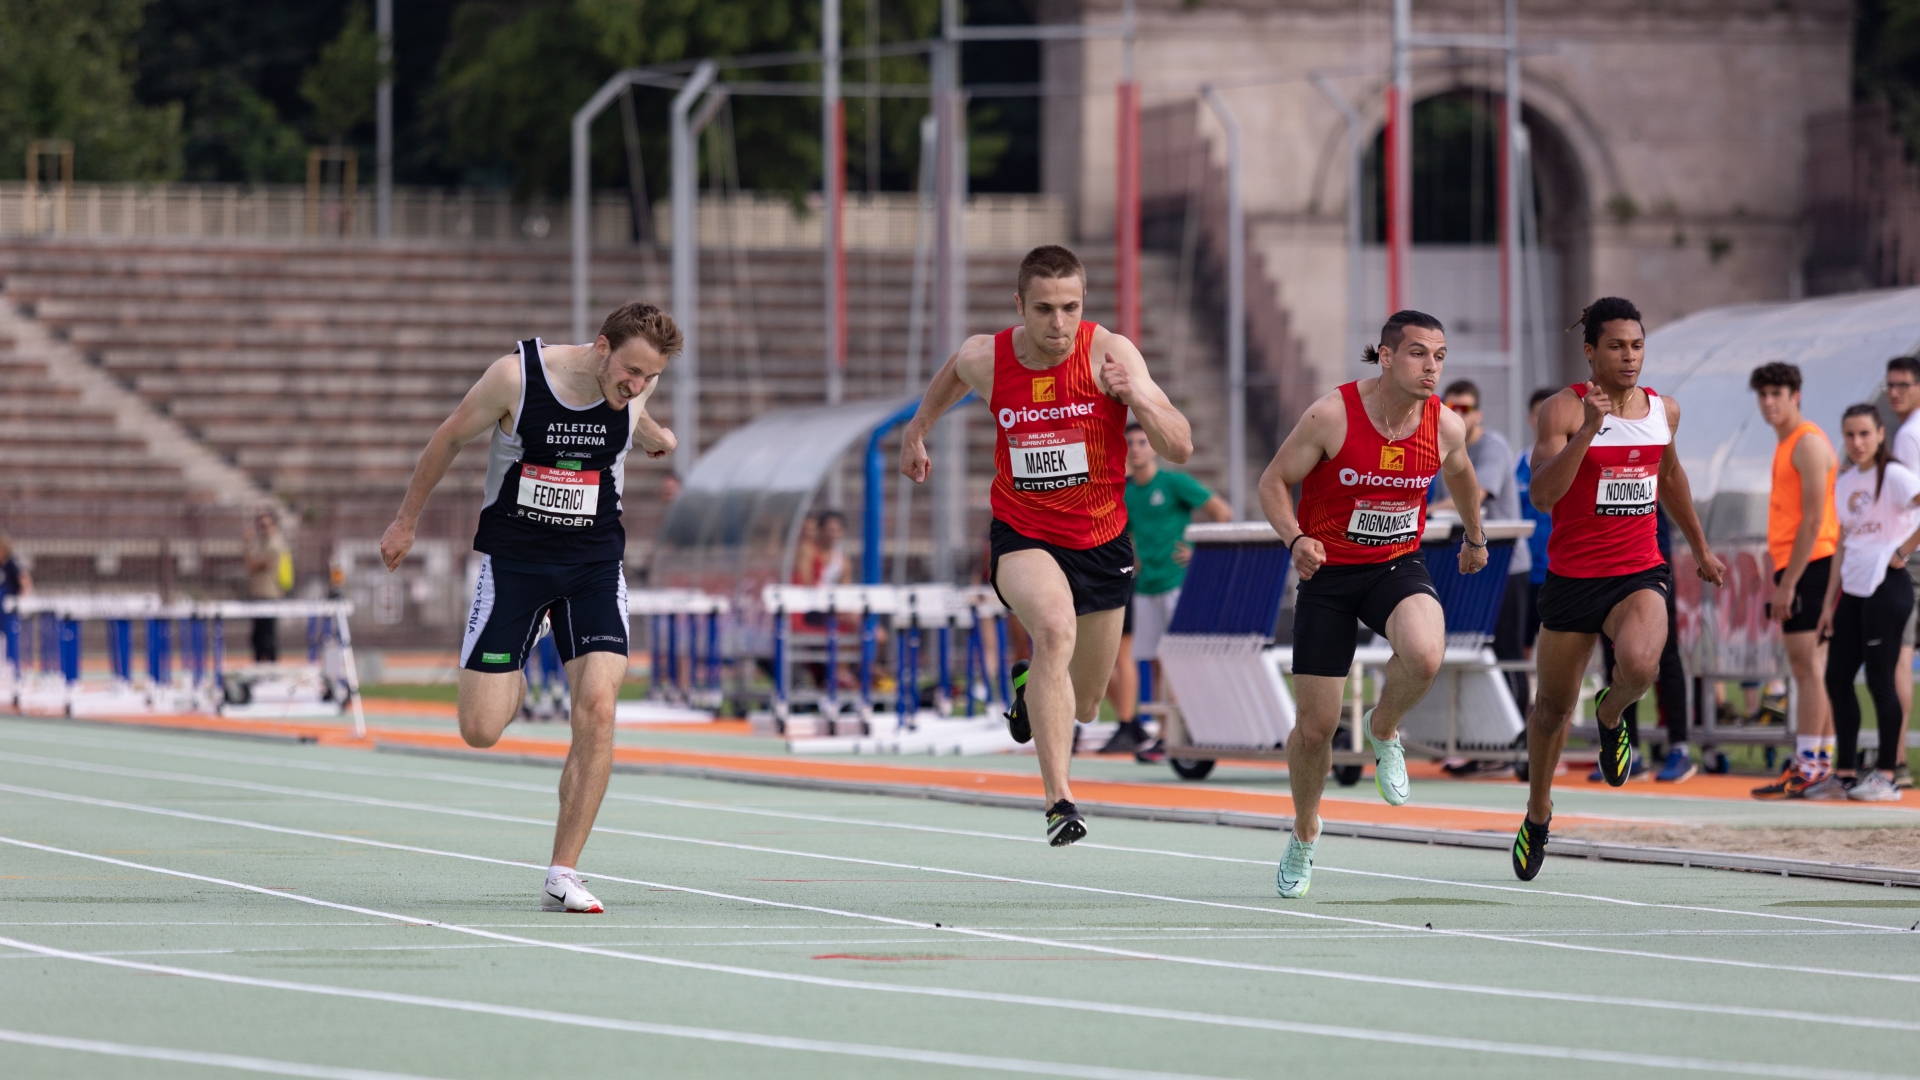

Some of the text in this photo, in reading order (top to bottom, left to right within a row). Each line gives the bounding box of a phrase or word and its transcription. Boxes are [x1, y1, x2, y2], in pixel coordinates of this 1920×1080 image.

[999, 402, 1095, 429] Oriocenter
[547, 423, 607, 434] ATLETICA
[1028, 432, 1055, 440] MILANO
[546, 435, 606, 446] BIOTEKNA
[1024, 450, 1067, 474] MAREK
[540, 474, 564, 483] SPRINT
[548, 469, 576, 477] MILANO
[1339, 467, 1435, 489] Oriocenter
[1022, 476, 1088, 490] CITROËN
[1605, 480, 1652, 501] NDONGALA
[533, 484, 585, 511] FEDERICI
[1605, 505, 1656, 516] CITROËN
[527, 511, 594, 527] CITROËN
[1357, 511, 1414, 533] RIGNANESE
